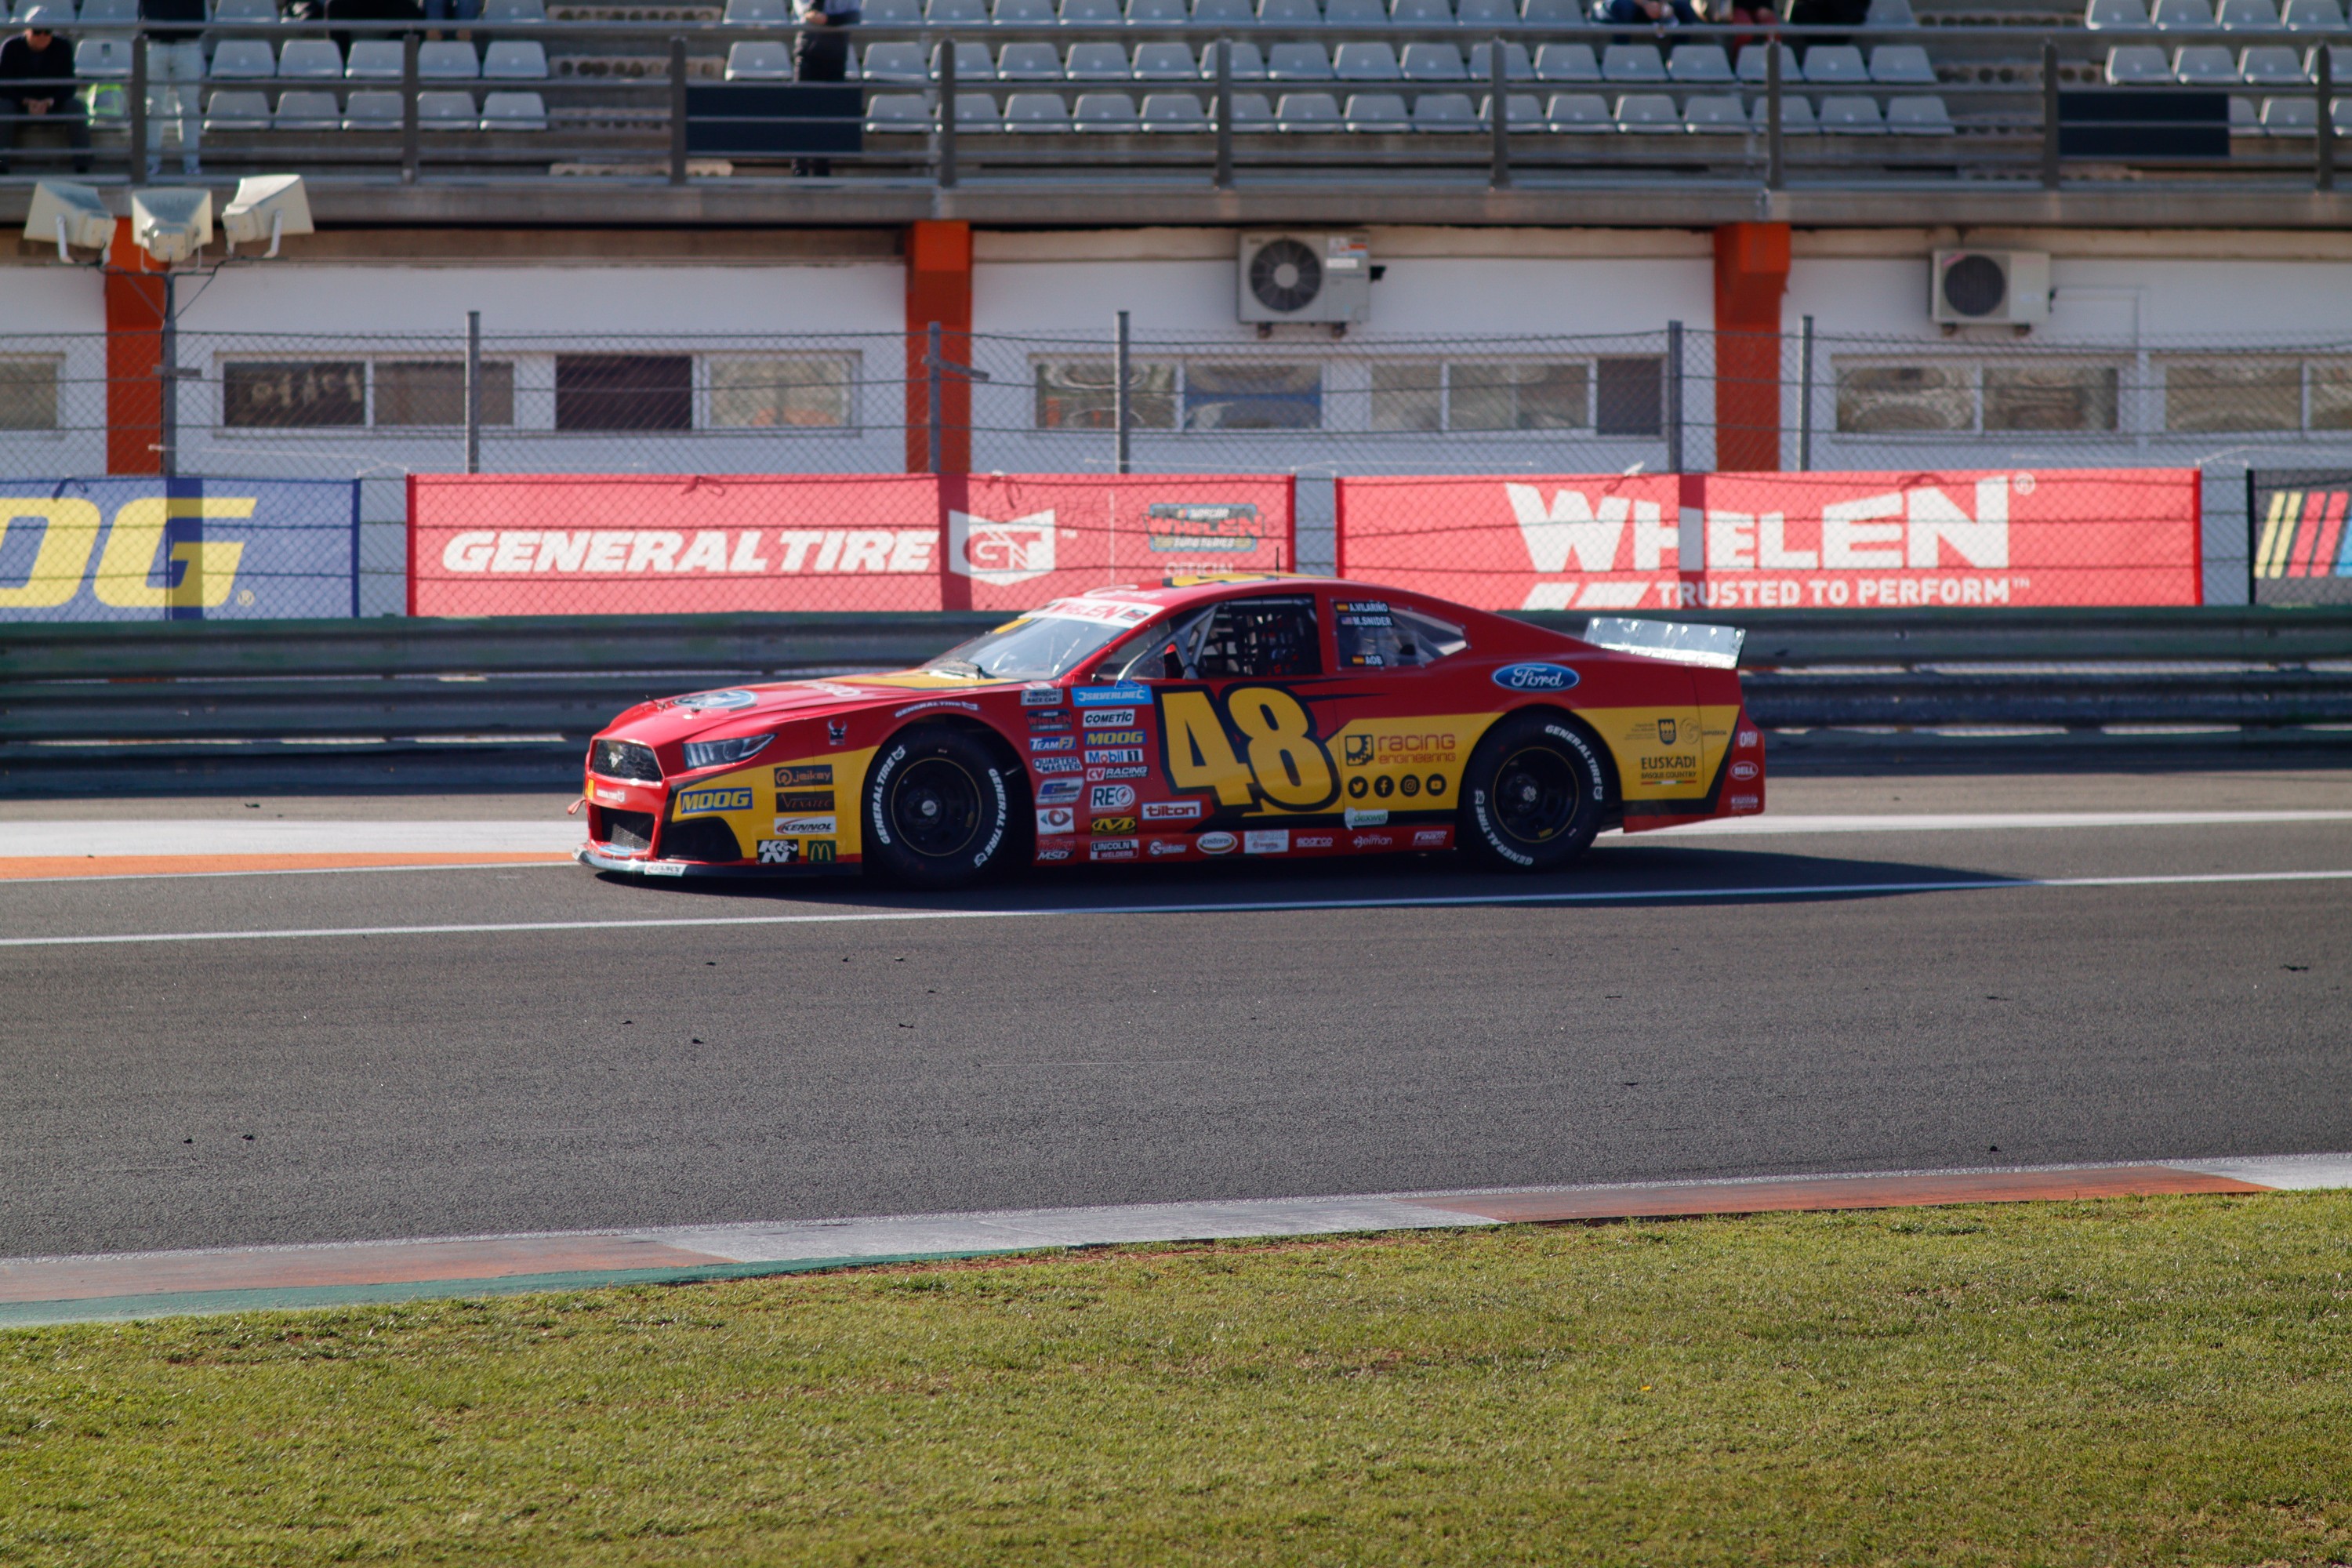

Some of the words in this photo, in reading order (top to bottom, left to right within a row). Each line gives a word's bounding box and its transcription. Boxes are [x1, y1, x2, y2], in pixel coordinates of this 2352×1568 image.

[1504, 476, 2009, 572] WHELEN
[442, 530, 768, 572] GENERAL
[779, 530, 940, 572] TIRE
[1657, 580, 1799, 608] TRUSTED
[1809, 579, 1849, 605] TO
[1858, 577, 2009, 604] PERFORM
[1511, 666, 1565, 688] Ford
[1087, 731, 1144, 745] MOOG
[1161, 687, 1334, 806] 48
[1088, 751, 1124, 764] Mobil
[1544, 724, 1592, 760] GENERAL
[1587, 757, 1602, 785] TIRE
[1641, 756, 1697, 770] EUSKADI
[877, 757, 895, 785] TIRE
[1105, 766, 1148, 775] RACING
[682, 790, 750, 811] MOOG
[988, 768, 1007, 826] GENERAL
[873, 786, 891, 844] GENERAL
[1146, 806, 1196, 817] tilton
[1476, 806, 1493, 840] TIRE
[781, 822, 833, 831] KENNOL
[985, 827, 1004, 856] TIRE
[1093, 842, 1131, 851] LINCOLN
[1487, 835, 1534, 866] GENERAL
[1036, 851, 1070, 861] MSD
